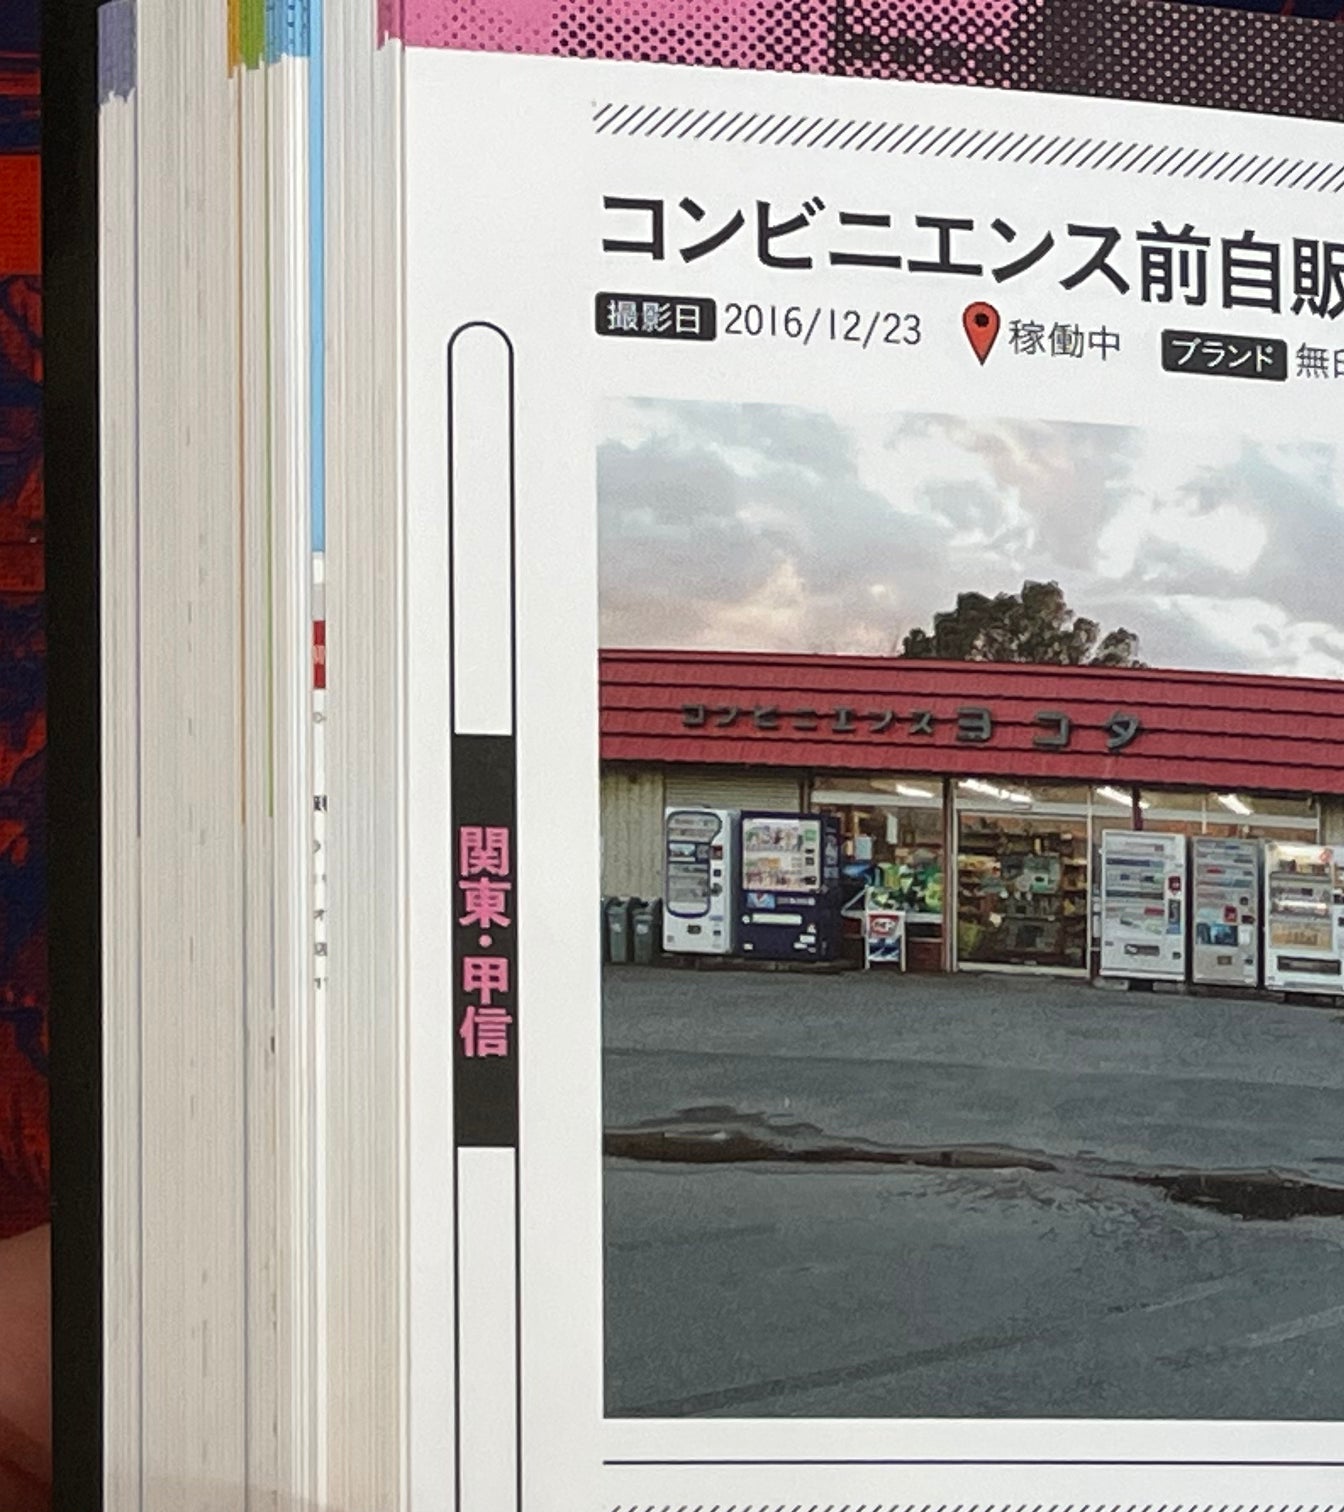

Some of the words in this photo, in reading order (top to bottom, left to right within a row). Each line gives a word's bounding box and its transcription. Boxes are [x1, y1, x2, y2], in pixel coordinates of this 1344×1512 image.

[604, 300, 704, 336] 撮影日
[724, 302, 923, 349] 2016/12/23
[1008, 318, 1121, 361] 稼働中
[1169, 337, 1275, 374] ブランド
[458, 826, 513, 1057] 関東・甲信
